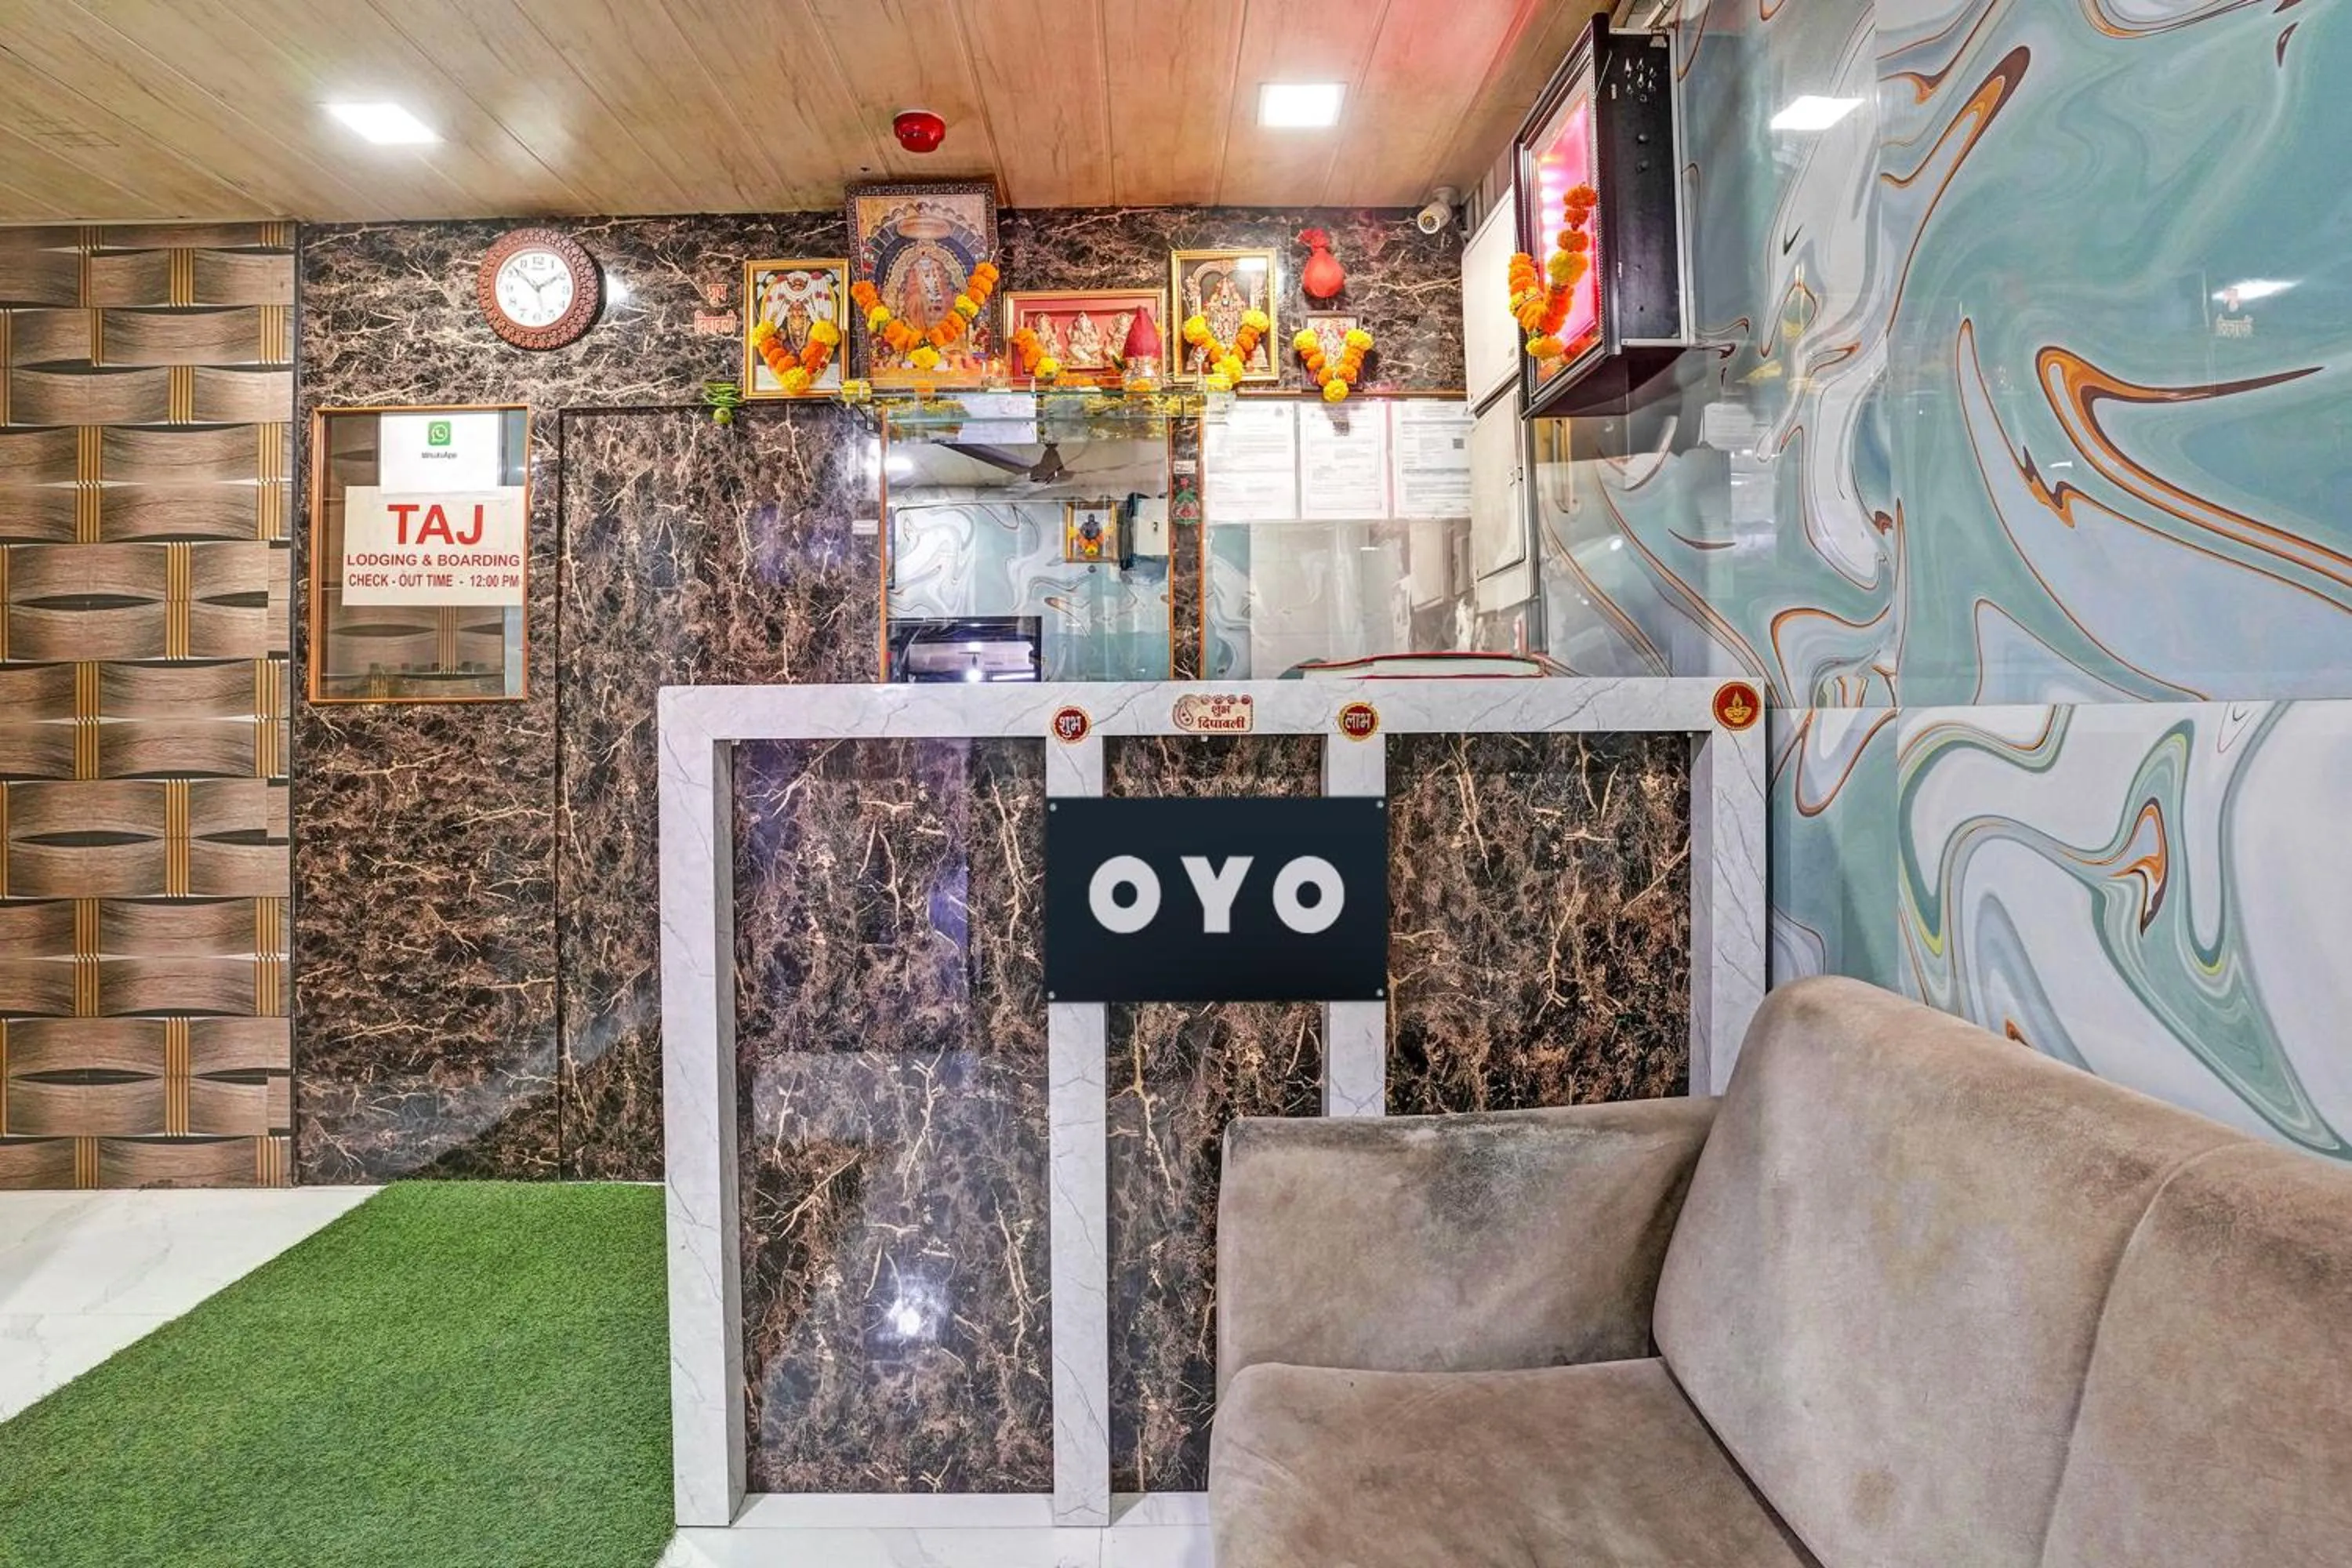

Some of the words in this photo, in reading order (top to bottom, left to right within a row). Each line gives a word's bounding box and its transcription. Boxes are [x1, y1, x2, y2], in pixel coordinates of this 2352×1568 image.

[387, 504, 484, 545] TAJ
[347, 554, 417, 566] LODGING
[422, 554, 432, 566] &
[437, 554, 520, 566] BOARDING
[348, 574, 389, 587] CHECK
[398, 574, 423, 587] OUT
[426, 574, 452, 587] TIME
[470, 575, 499, 587] 12:00
[502, 575, 519, 587] PM
[1211, 706, 1230, 717] शुभ
[1059, 715, 1081, 738] शुभ
[1345, 713, 1371, 729] लाभ
[1088, 855, 1345, 934] OYO
